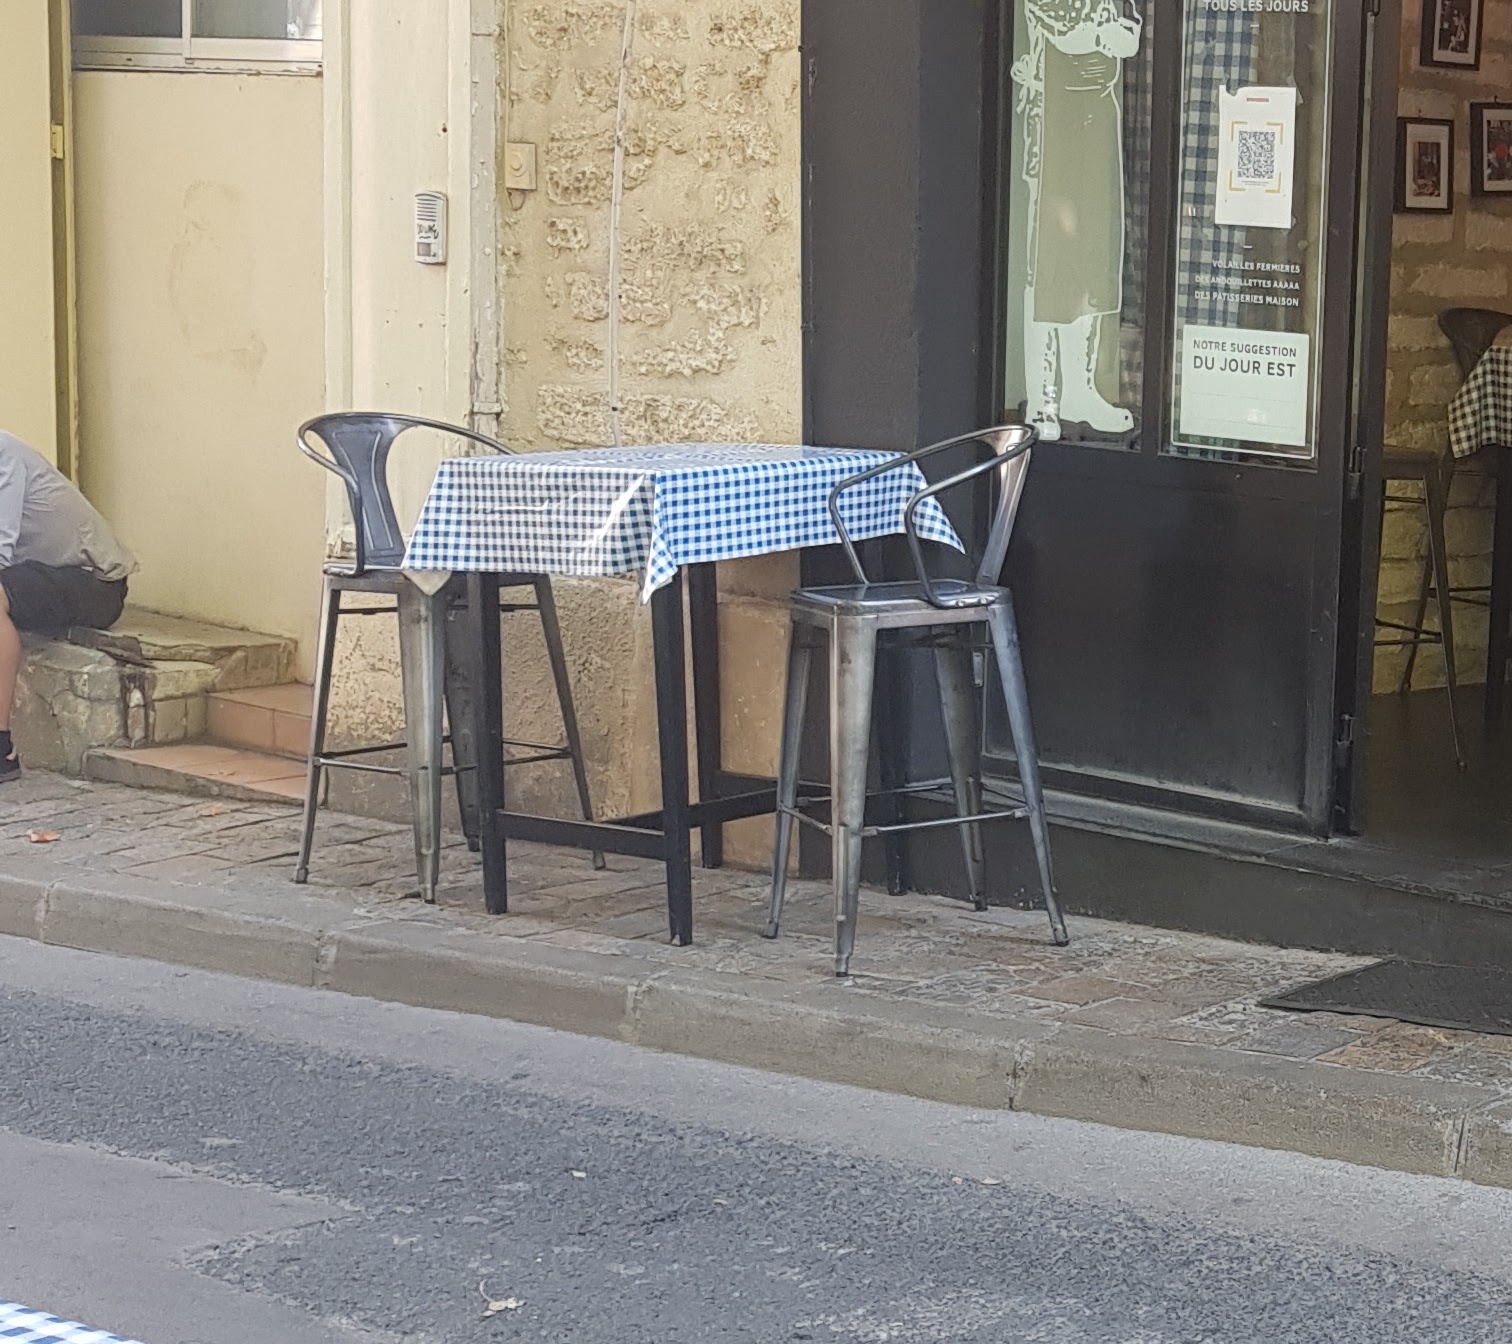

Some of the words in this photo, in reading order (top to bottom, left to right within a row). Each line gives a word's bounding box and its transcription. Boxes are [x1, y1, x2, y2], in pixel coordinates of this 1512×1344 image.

[1204, 0, 1237, 11] TOUS
[1241, 0, 1263, 11] LES
[1266, 0, 1309, 12] JOURS
[1212, 260, 1254, 270] VOLAILLES
[1195, 274, 1210, 284] DES
[1211, 276, 1272, 288] ANDOUILLETTES
[1194, 290, 1210, 300] DES
[1265, 295, 1299, 307] MAISON
[1193, 339, 1227, 352] NOTRE
[1230, 342, 1297, 357] SUGGESTION
[1193, 356, 1214, 370] DU
[1220, 358, 1261, 375] JOUR
[1267, 362, 1296, 377] EST
